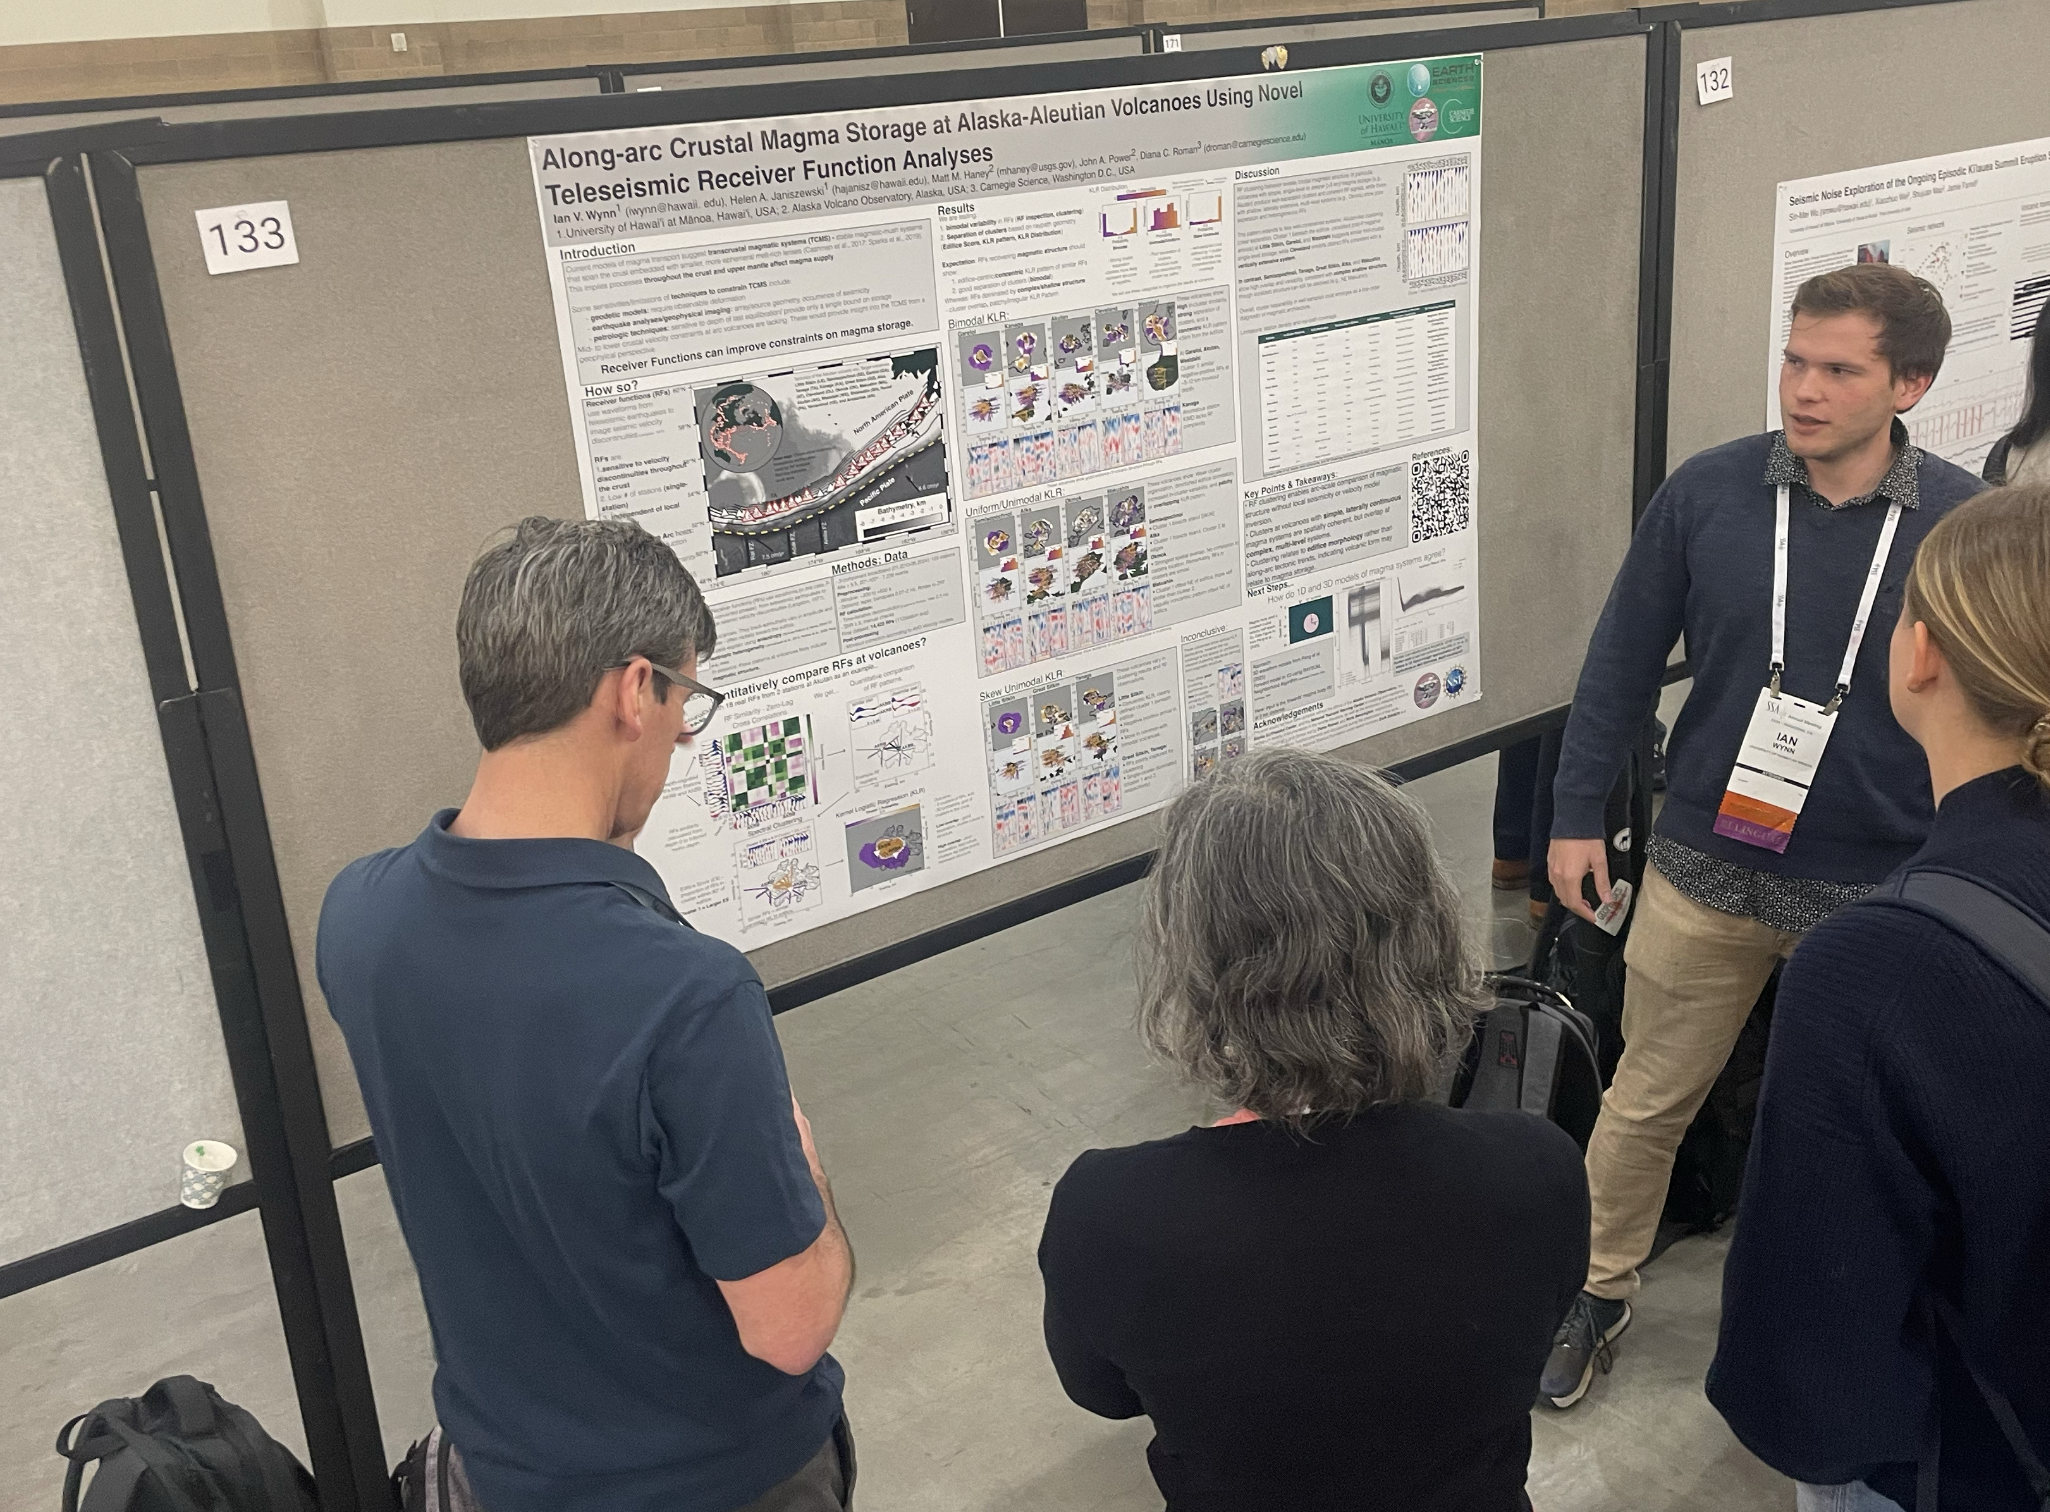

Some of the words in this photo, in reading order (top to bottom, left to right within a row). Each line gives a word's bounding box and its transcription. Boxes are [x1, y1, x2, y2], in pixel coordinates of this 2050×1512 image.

[1165, 38, 1179, 48] 171
[1432, 62, 1474, 78] EARTH
[1432, 76, 1474, 86] SCIENCES
[1700, 68, 1730, 93] 132
[542, 143, 663, 171] Along-arc
[670, 131, 754, 159] Crustal
[760, 129, 840, 153] Magma
[846, 120, 927, 143] Storage
[933, 115, 951, 135] at
[958, 101, 1106, 132] Alaska-Aleutian
[1111, 94, 1201, 117] Volcanoes
[1206, 87, 1253, 108] Using
[1258, 80, 1303, 102] Novel
[1358, 111, 1404, 125] UNIVERSITY
[1360, 127, 1368, 135] of
[545, 173, 690, 206] Teleseismic
[698, 165, 796, 191] Receiver
[803, 154, 896, 181] Function
[903, 146, 993, 170] Analyses
[1235, 166, 1280, 180] Discussion
[1789, 194, 1820, 207] Seismic
[1821, 188, 1842, 201] Noise
[1844, 180, 1885, 197] Exploration
[1886, 178, 1894, 189] of
[1895, 177, 1906, 188] the
[1908, 172, 1937, 186] Ongoing
[1938, 166, 1967, 181] Episodic
[1994, 157, 2019, 170] Summit
[2020, 153, 2048, 167] Eruption
[553, 214, 571, 224] Ian
[574, 211, 584, 222] V.
[730, 192, 758, 205] Helen
[759, 192, 769, 203] A.
[932, 173, 950, 184] Matt
[952, 172, 962, 182] M.
[1079, 156, 1098, 168] John
[1099, 154, 1108, 165] A.
[1140, 149, 1162, 160] Diana
[1162, 148, 1170, 158] C.
[618, 222, 628, 232] of
[667, 218, 677, 228] at
[755, 206, 779, 218] USA;
[781, 204, 790, 214] 2.
[792, 201, 822, 213] Alaska
[824, 197, 859, 210] Volcano
[860, 192, 914, 208] Observatory,
[915, 188, 946, 200] Alaska,
[947, 186, 970, 198] USA;
[970, 184, 980, 194] 3.
[980, 178, 1015, 192] Carnegie
[1017, 176, 1051, 189] Science,
[1052, 171, 1096, 186] Washington
[1118, 166, 1136, 176] USA
[938, 203, 975, 216] Results
[210, 216, 285, 256] 133
[559, 242, 636, 260] Introduction
[644, 273, 682, 284] throughout
[695, 269, 712, 278] crust
[726, 264, 746, 274] upper
[747, 262, 769, 271] mantle
[770, 258, 788, 268] affect
[789, 256, 813, 266] magma
[670, 290, 708, 300] techniques
[708, 287, 716, 295] to
[716, 283, 748, 294] constrain
[748, 281, 768, 289] TCMS
[948, 316, 984, 329] Bimodal
[987, 312, 1010, 322] KLR:
[600, 360, 648, 374] Receiver
[650, 352, 703, 368] Functions
[705, 349, 724, 358] can
[726, 342, 767, 356] improve
[769, 333, 824, 348] constraints
[826, 331, 838, 340] on
[840, 324, 876, 338] magma
[877, 320, 914, 332] storage.
[584, 386, 614, 398] How
[616, 380, 638, 393] so?
[854, 420, 870, 435] North
[871, 401, 898, 424] American
[898, 389, 914, 402] Plate
[859, 490, 881, 506] Pacific
[880, 477, 896, 491] Plate
[1244, 490, 1259, 500] Key
[1261, 484, 1286, 496] Points
[1287, 481, 1293, 489] &
[1295, 472, 1338, 487] Takeaways:
[878, 500, 916, 516] Bathymetry,
[966, 492, 1042, 517] Uniform/Unimodal
[1044, 488, 1065, 498] KLR:
[831, 558, 882, 576] Methods:
[884, 550, 908, 563] Data
[1268, 593, 1284, 604] How
[1286, 590, 1296, 599] do
[1296, 586, 1306, 598] 1D
[1307, 583, 1322, 594] and
[1322, 579, 1334, 589] 3D
[1334, 573, 1360, 586] models
[1360, 570, 1368, 579] of
[1370, 566, 1394, 578] magma
[1396, 556, 1422, 571] systems
[1424, 548, 1446, 564] agree?
[1248, 588, 1265, 598] Next
[1266, 582, 1294, 594] Steps...
[1180, 624, 1228, 644] Inconclusive:
[724, 678, 778, 700] ntitatively
[782, 664, 830, 685] compare
[832, 658, 853, 671] RFs
[856, 654, 866, 665] at
[869, 638, 926, 661] volcanoes?
[980, 688, 1002, 702] Skew
[1004, 676, 1043, 694] Unimodal
[1254, 702, 1324, 730] Acknowledgements
[1766, 701, 1780, 714] SSA
[1772, 742, 1796, 754] WYNN
[1776, 732, 1798, 746] IAN
